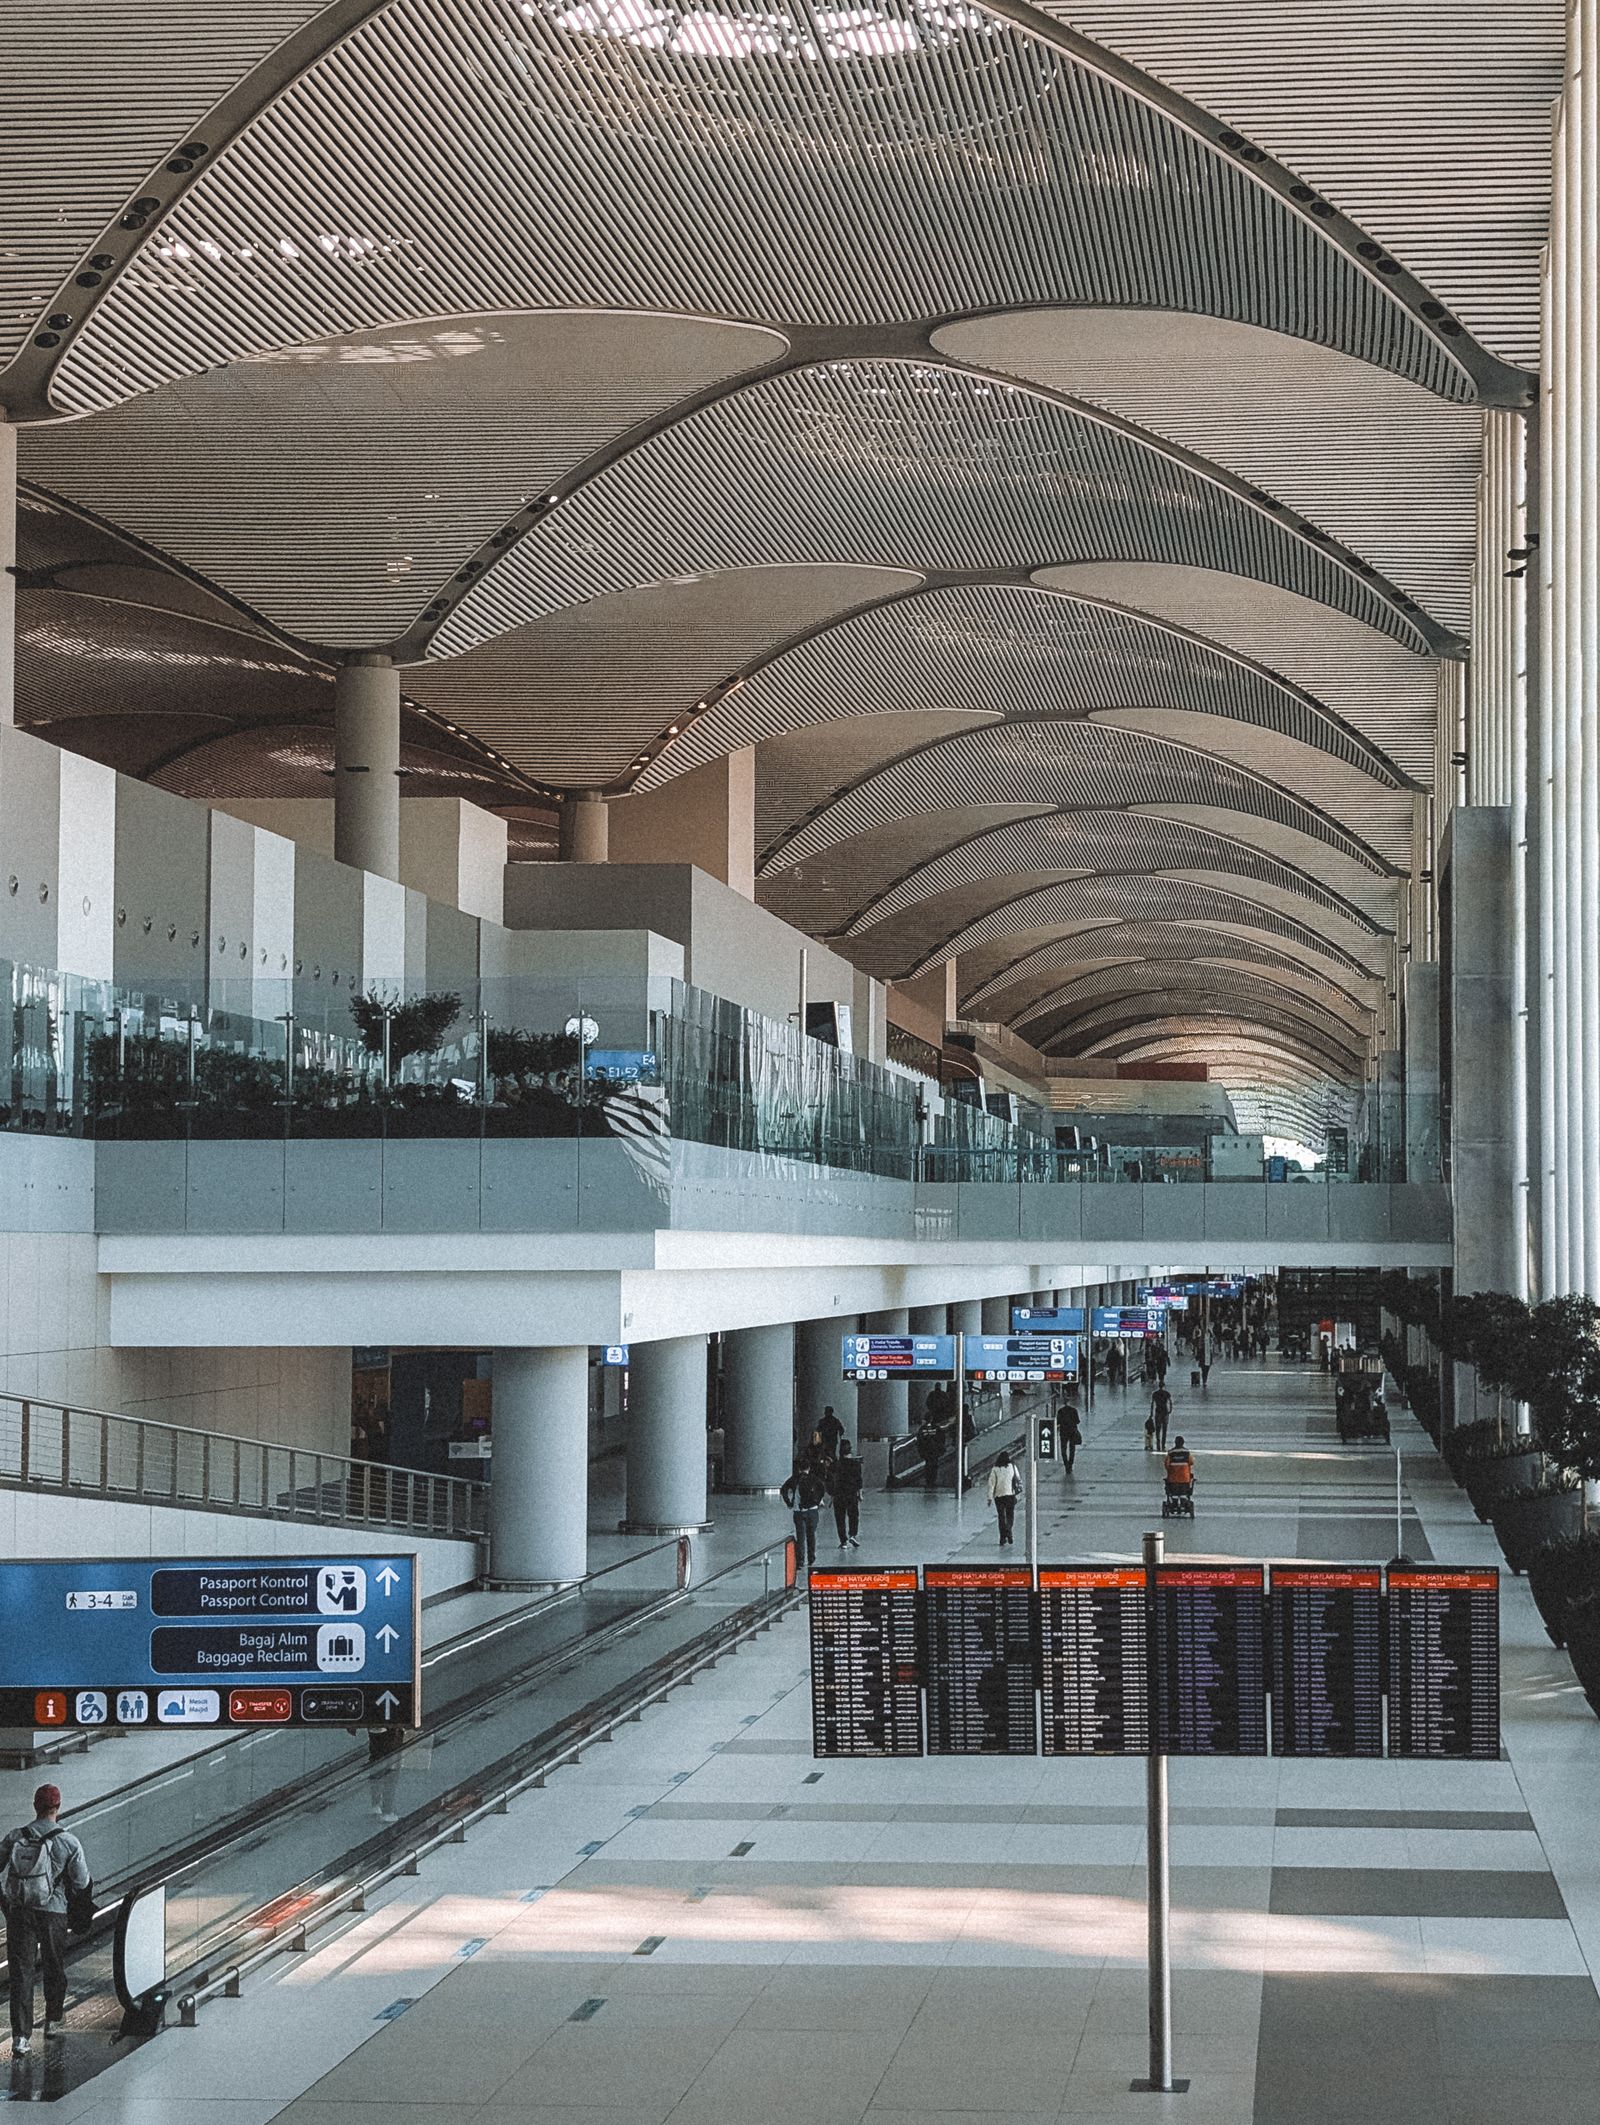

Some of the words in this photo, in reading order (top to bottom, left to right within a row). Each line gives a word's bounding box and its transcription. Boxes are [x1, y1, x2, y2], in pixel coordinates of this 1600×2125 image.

[200, 1576, 257, 1592] Pasaport
[260, 1574, 308, 1588] Kontrol
[87, 1594, 113, 1608] 3-4
[200, 1594, 257, 1609] Passport
[260, 1592, 308, 1606] Control
[240, 1633, 275, 1649] Bagaj
[197, 1650, 254, 1666] Baggage
[257, 1649, 308, 1662] Reclaim
